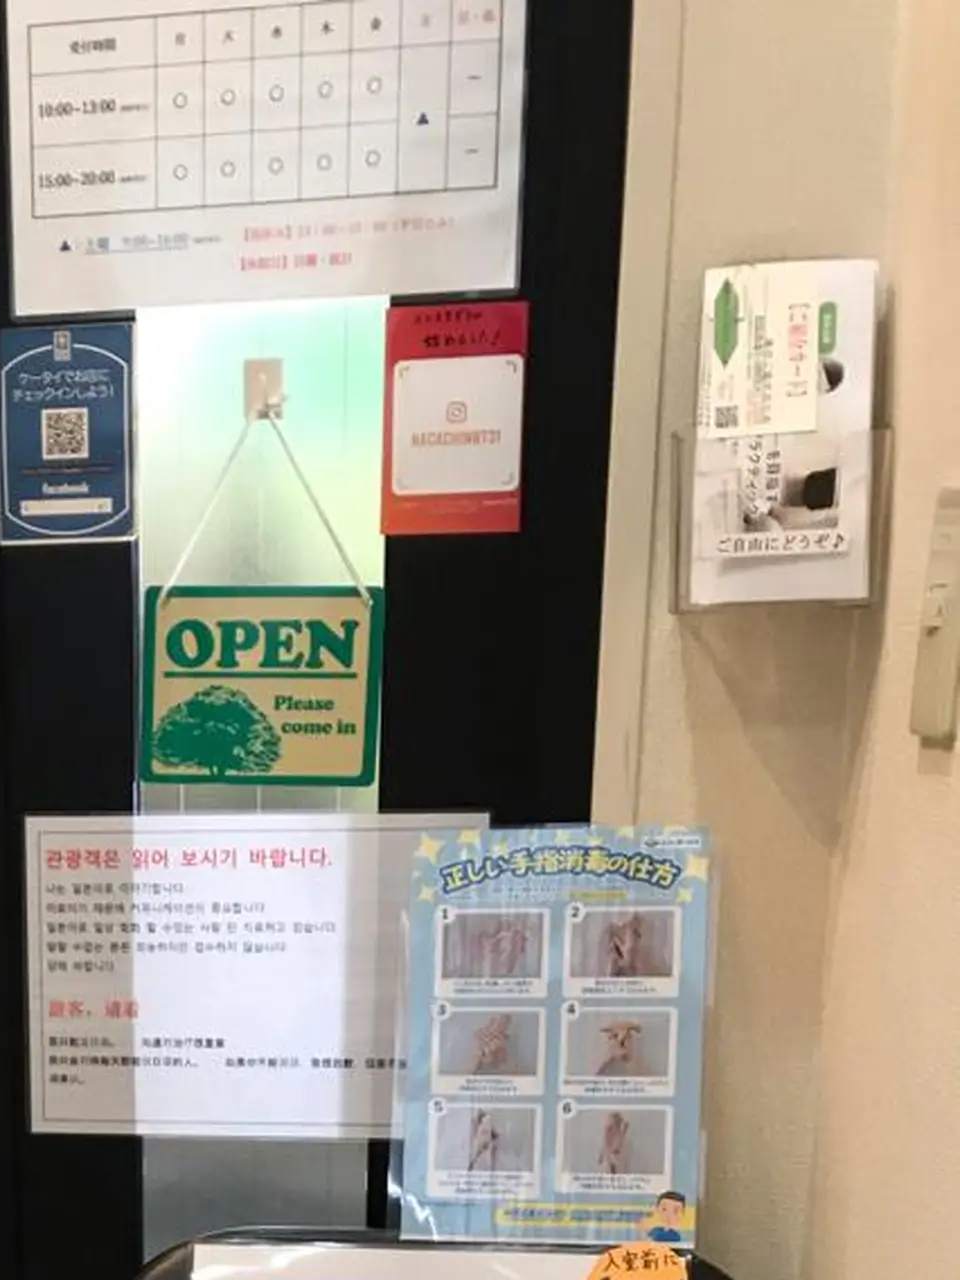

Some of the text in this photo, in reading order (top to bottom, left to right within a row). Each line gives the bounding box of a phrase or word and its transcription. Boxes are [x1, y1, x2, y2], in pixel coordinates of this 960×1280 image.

[164, 618, 359, 671] OPEN
[273, 695, 334, 712] Please
[281, 717, 357, 735] come in
[180, 848, 238, 869] 보시기
[249, 847, 333, 868] 바랍니다.
